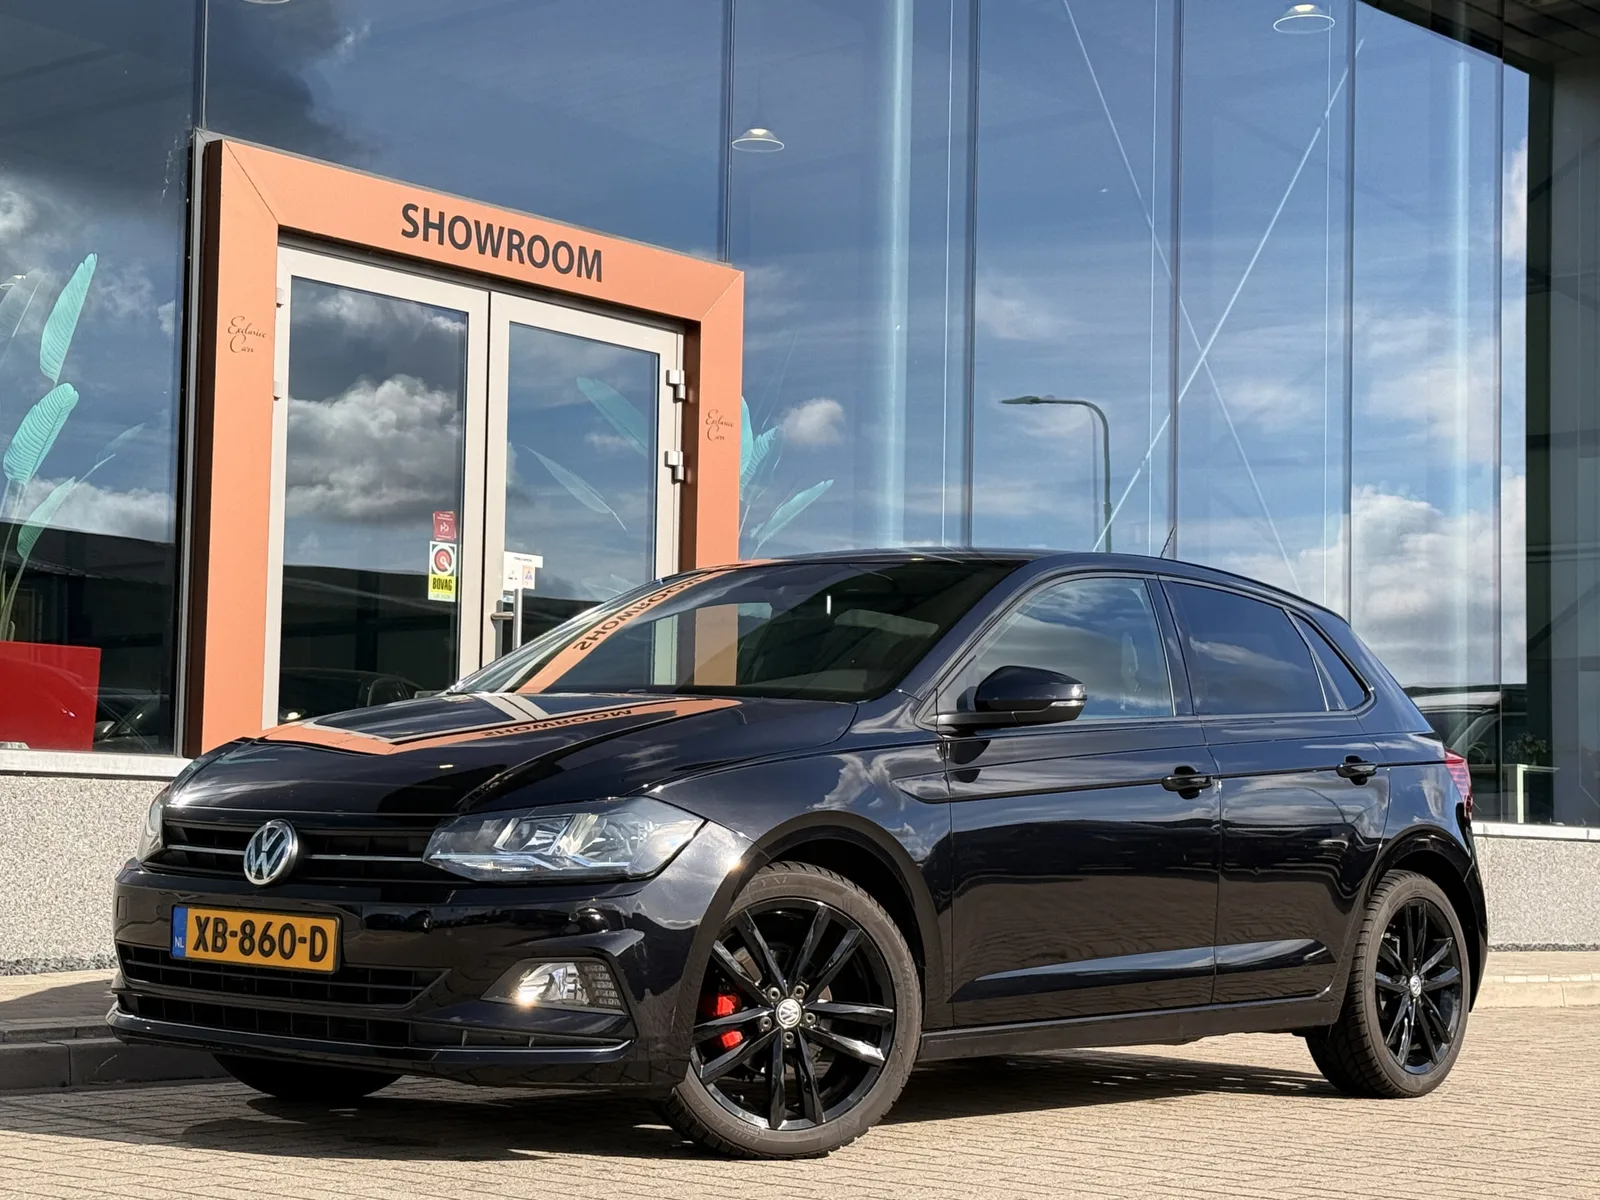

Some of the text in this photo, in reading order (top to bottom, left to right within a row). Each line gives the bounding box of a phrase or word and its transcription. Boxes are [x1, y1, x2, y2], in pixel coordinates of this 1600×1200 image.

[401, 203, 603, 283] SHOWROOM
[432, 577, 453, 592] BOVAG
[244, 821, 296, 884] VW
[174, 936, 185, 949] NL
[193, 915, 328, 963] XB-860-D
